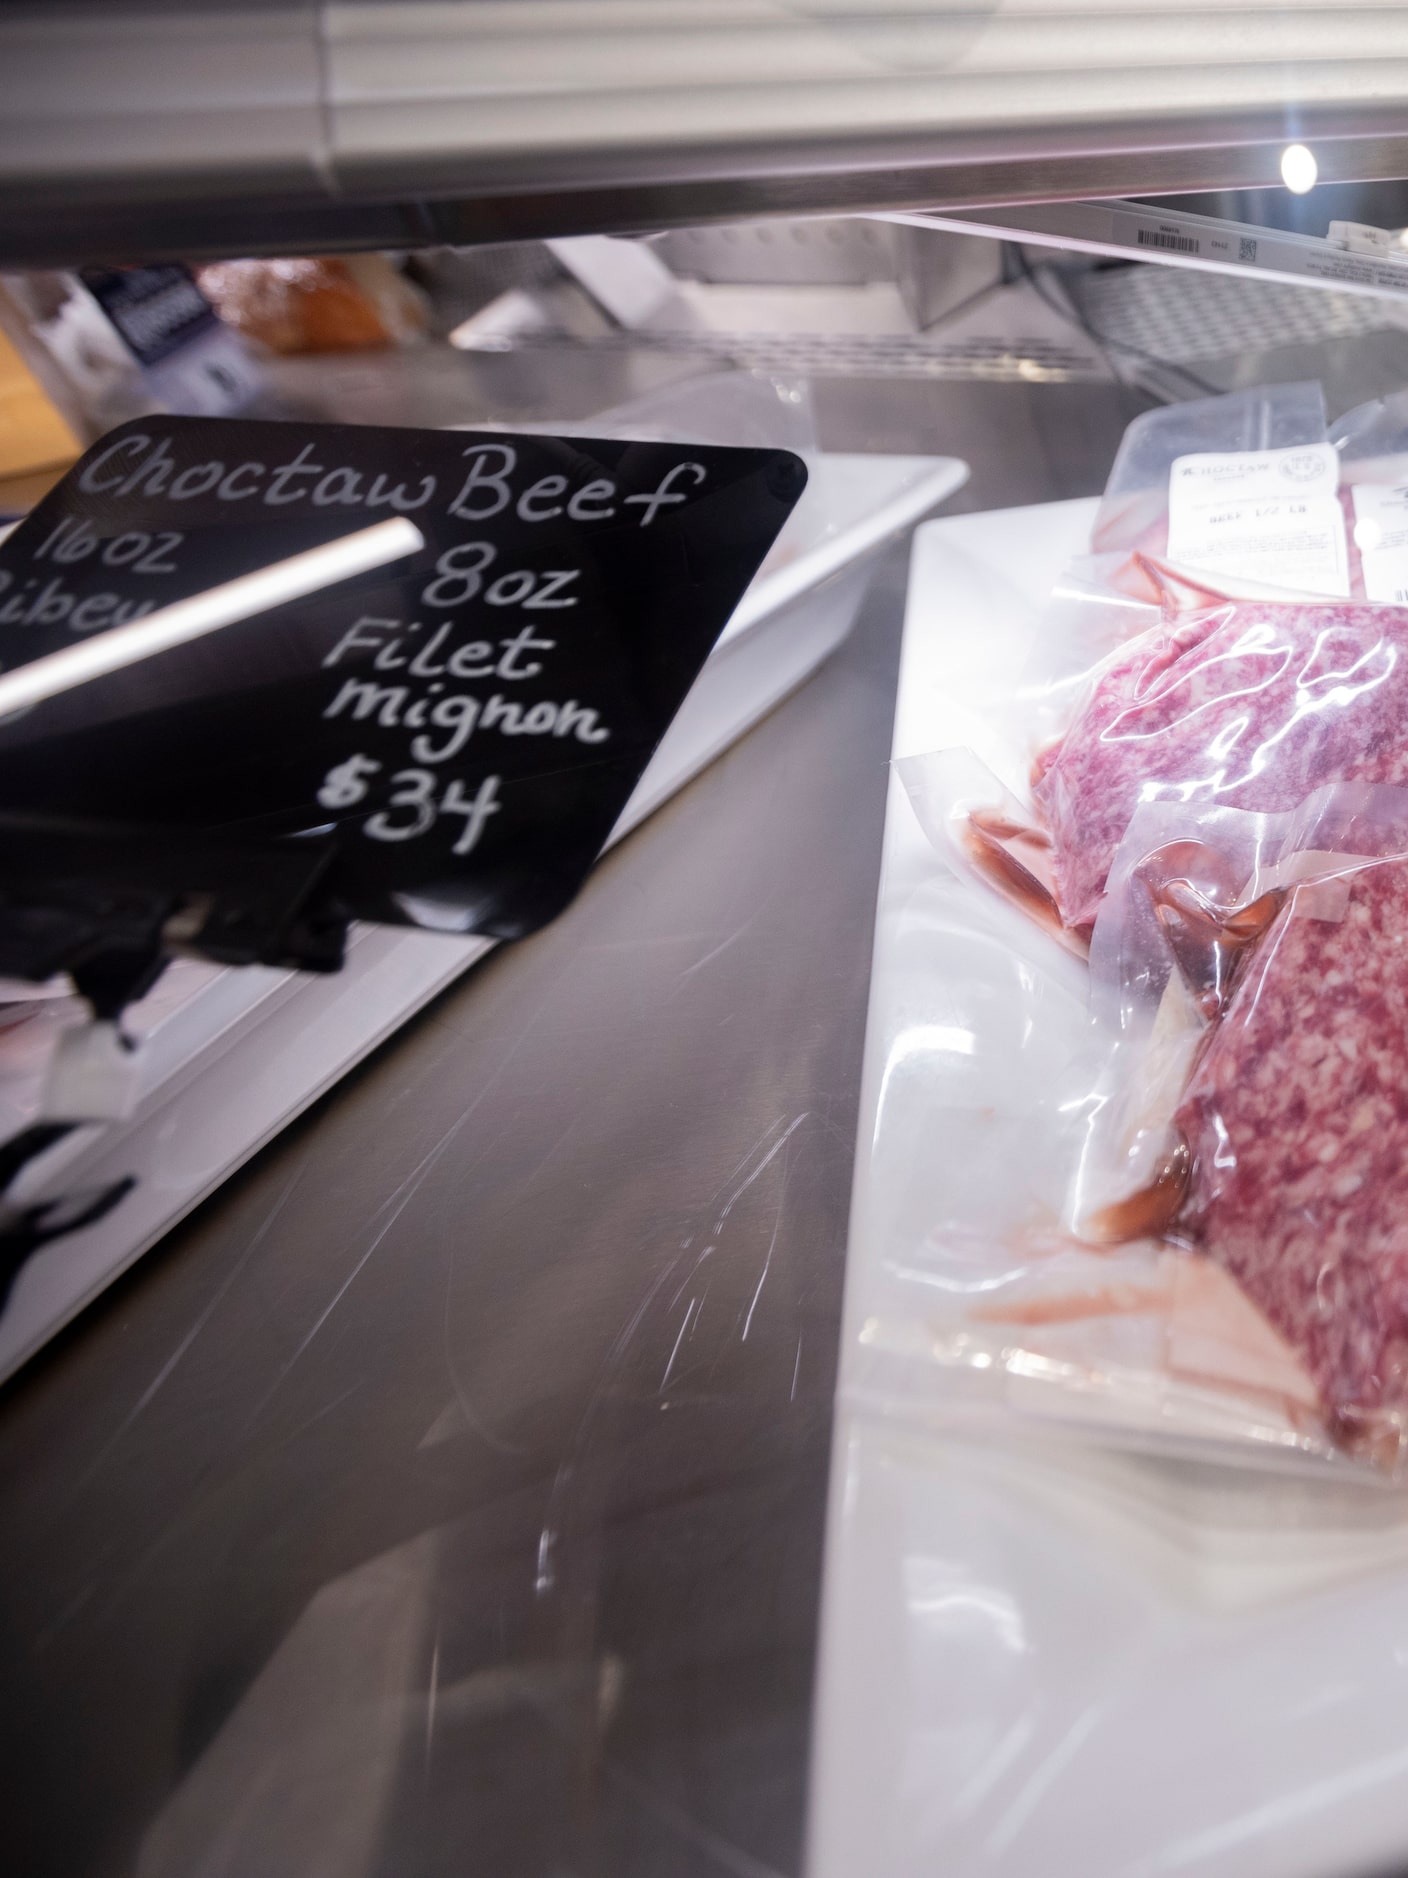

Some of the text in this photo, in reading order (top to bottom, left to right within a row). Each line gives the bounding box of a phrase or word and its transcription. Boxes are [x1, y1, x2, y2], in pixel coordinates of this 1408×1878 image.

[79, 434, 707, 526] Choctaw Beef
[322, 616, 556, 679] Filet
[323, 676, 609, 764] mignon
